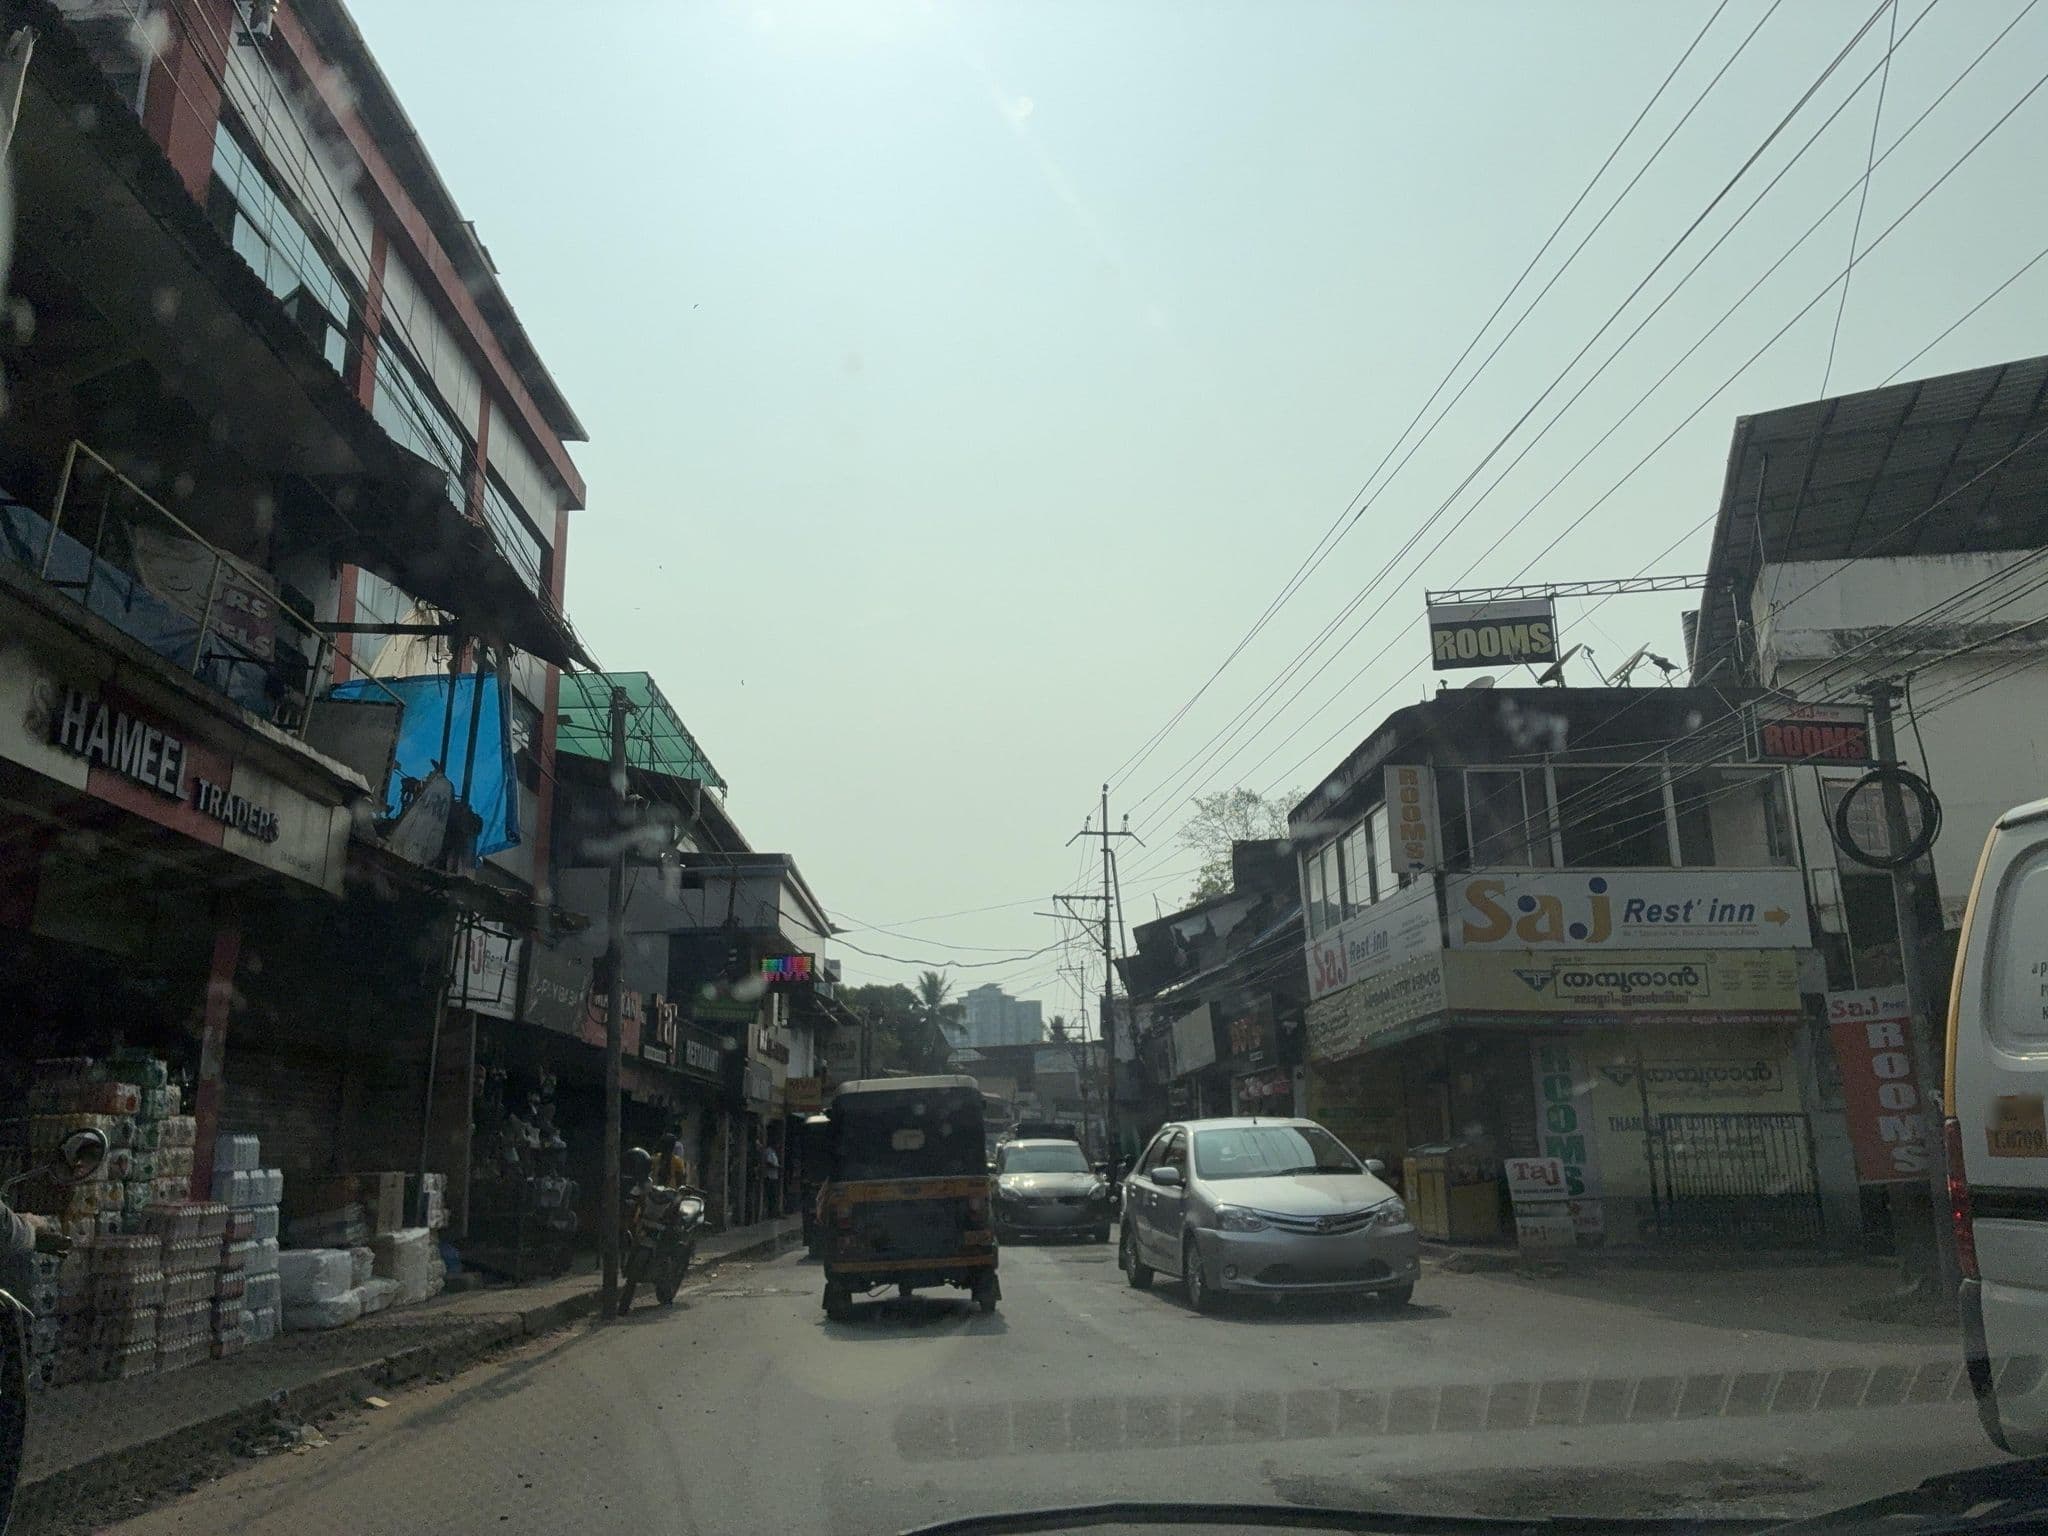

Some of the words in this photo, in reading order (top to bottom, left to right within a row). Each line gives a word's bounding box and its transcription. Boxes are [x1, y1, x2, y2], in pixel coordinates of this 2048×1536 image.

[1434, 623, 1553, 661] ROOMS
[1764, 724, 1866, 760] ROOMS
[198, 777, 281, 843] TRADERS
[1398, 765, 1427, 861] ROOMS
[1463, 877, 1612, 945] Saj
[1709, 897, 1755, 923] inn
[1313, 935, 1348, 993] Saj
[1831, 995, 1880, 1019] Saj
[1866, 1021, 1925, 1174] ROOMS
[1513, 1160, 1562, 1186] Taj
